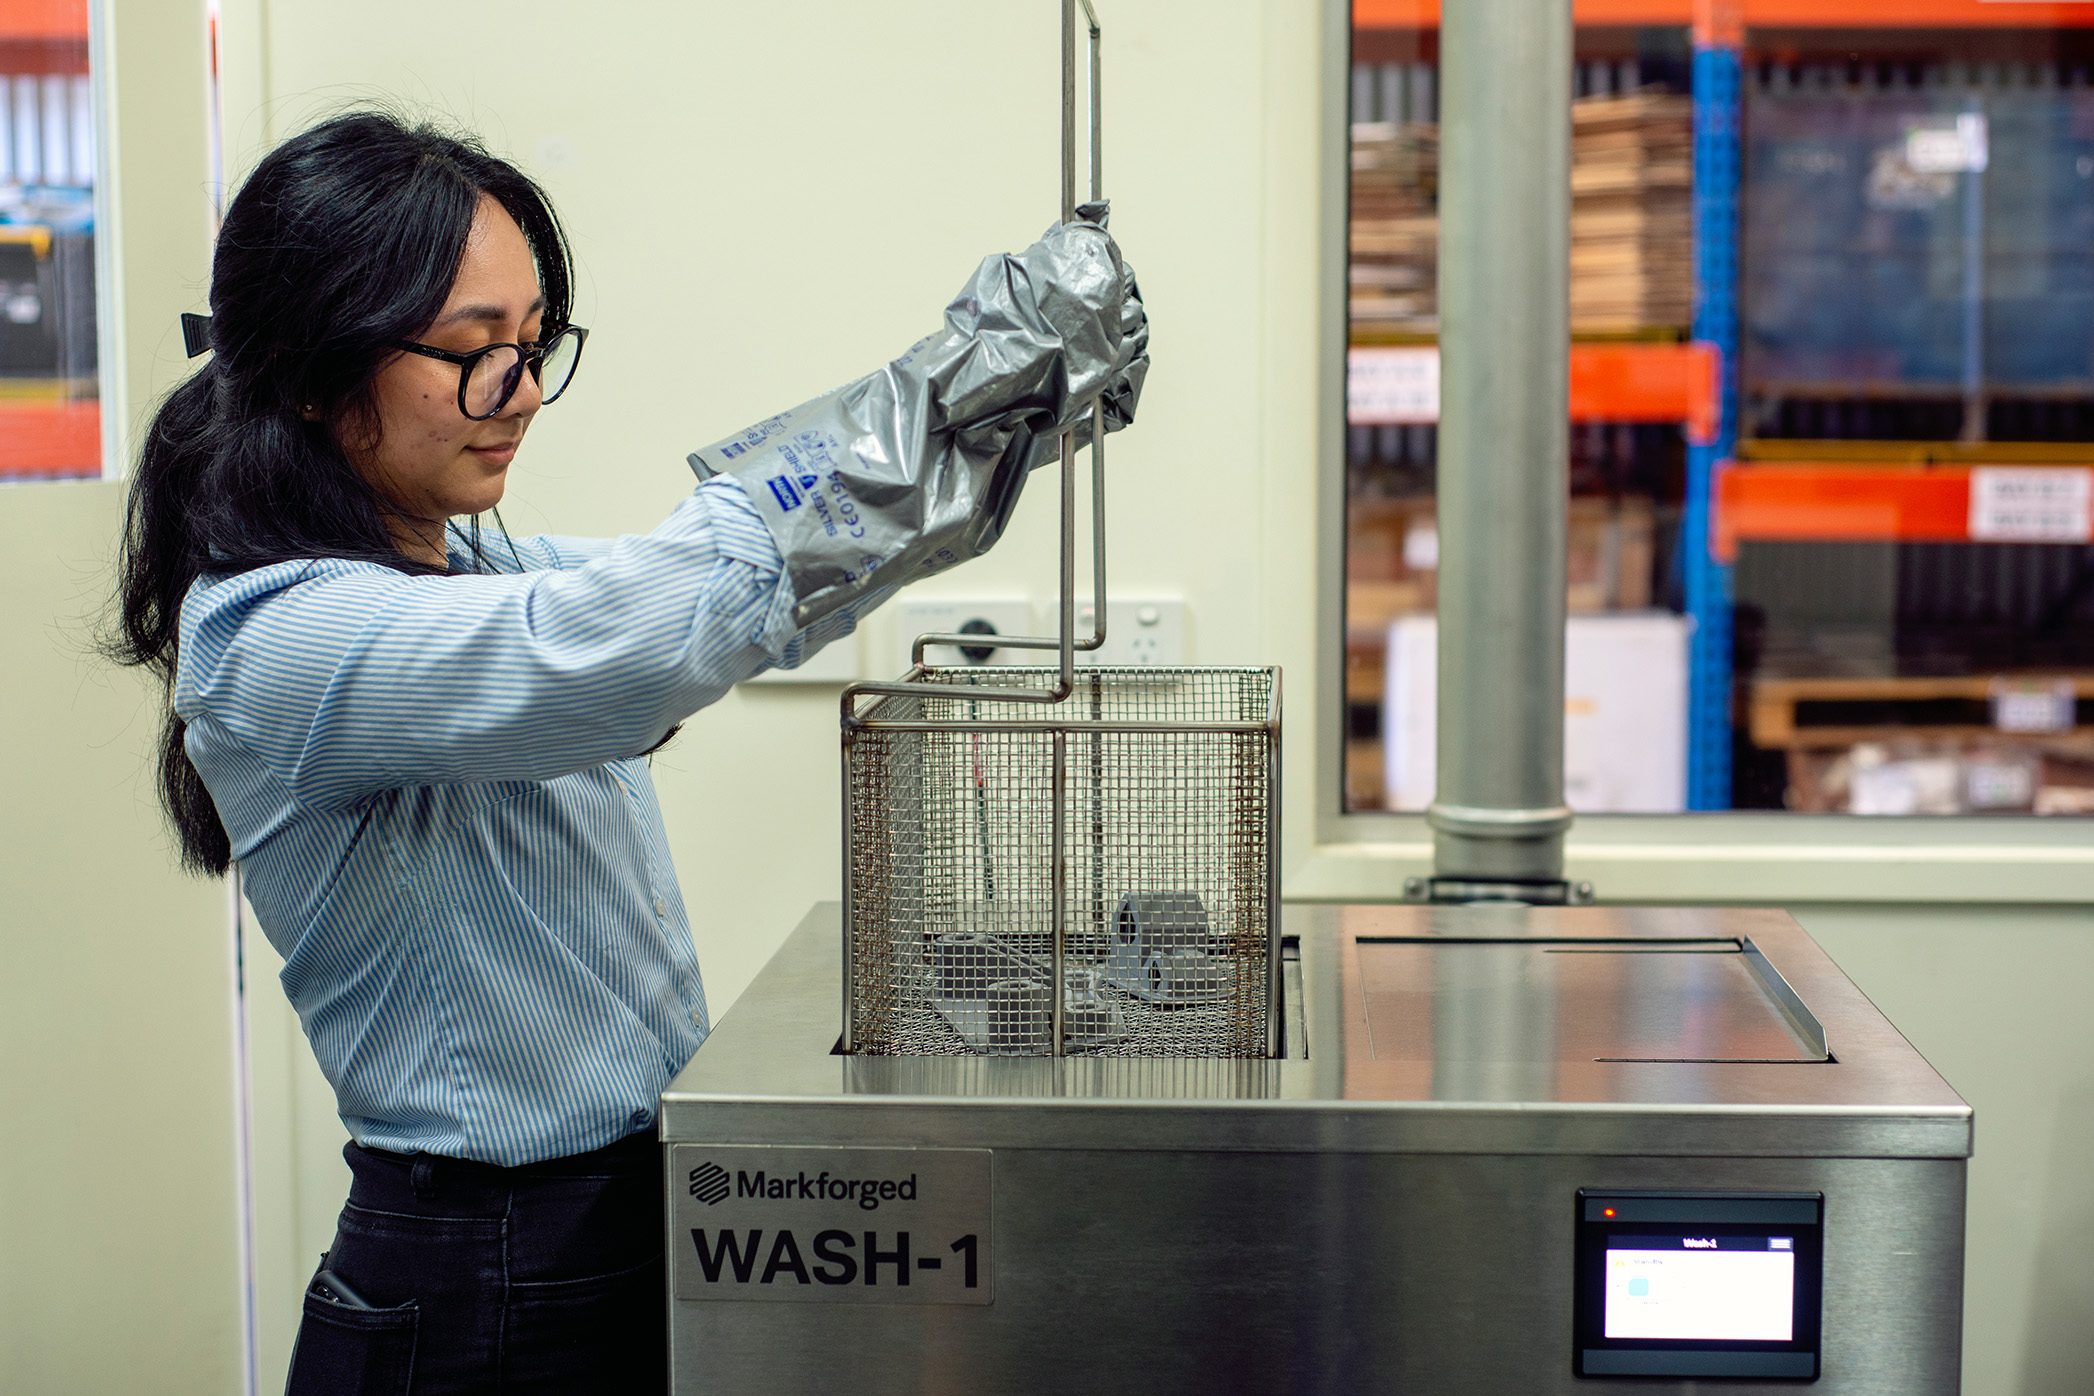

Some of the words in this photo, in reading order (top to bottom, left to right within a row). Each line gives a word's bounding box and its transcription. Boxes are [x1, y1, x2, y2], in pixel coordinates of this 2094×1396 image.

[777, 444, 807, 474] SHIELD
[772, 475, 799, 510] NORTH
[809, 490, 838, 537] SILVER
[737, 1170, 916, 1211] Markforged
[690, 1228, 978, 1289] WASH-1
